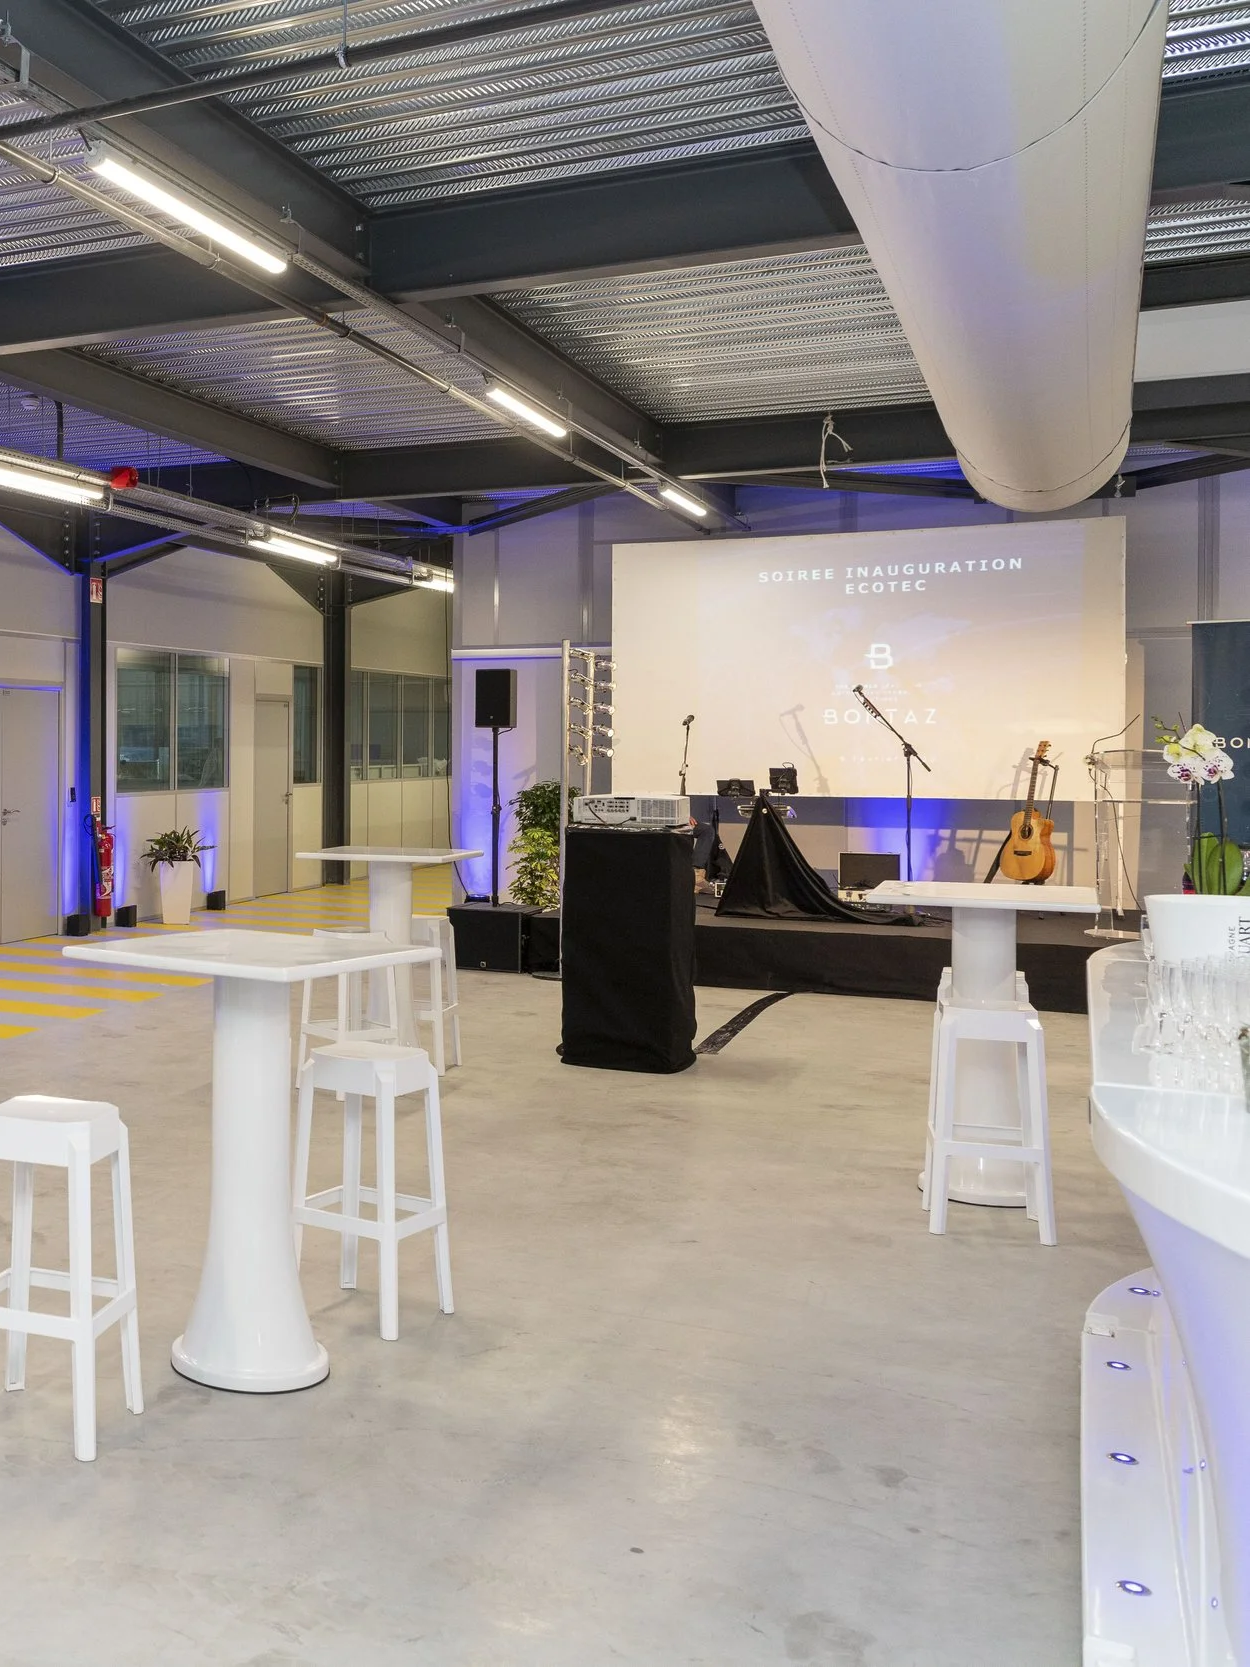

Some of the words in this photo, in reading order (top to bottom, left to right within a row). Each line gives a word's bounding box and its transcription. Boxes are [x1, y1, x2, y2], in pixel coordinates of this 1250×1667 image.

[759, 568, 835, 583] SOIREE
[845, 558, 1023, 579] INAUGURATION
[845, 580, 927, 595] ECOTEC
[864, 643, 894, 670] B
[823, 708, 937, 724] BOTAZ
[1213, 737, 1250, 749] BO
